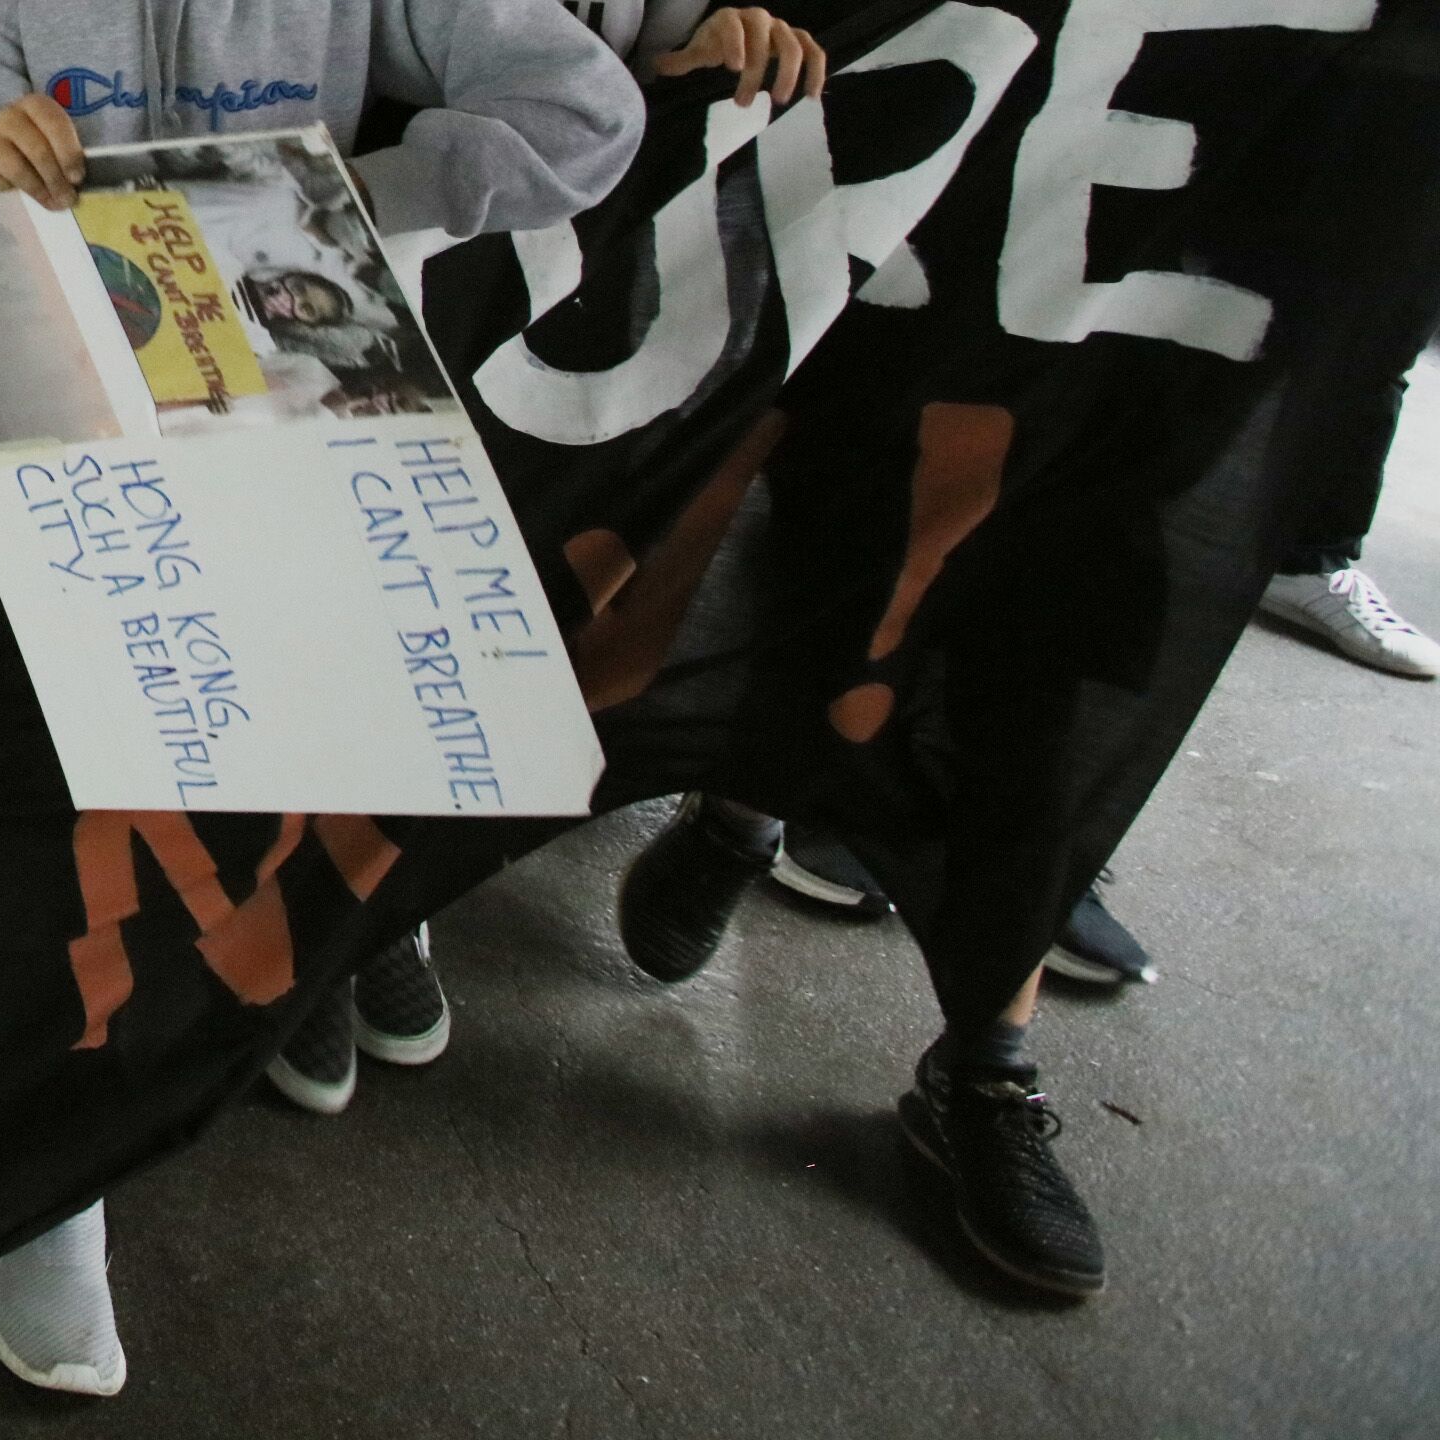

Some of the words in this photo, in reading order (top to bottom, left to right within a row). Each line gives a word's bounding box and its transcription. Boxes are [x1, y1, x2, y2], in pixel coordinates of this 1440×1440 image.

[143, 198, 207, 274] HELP
[62, 453, 131, 557] SUCH
[110, 459, 200, 589] HONG
[394, 437, 499, 551] HELP
[454, 564, 548, 659] ME!
[101, 573, 146, 598] A
[326, 436, 375, 449] I
[396, 628, 504, 811] BREATHE.
[121, 612, 219, 807] BEAUTIFUL
